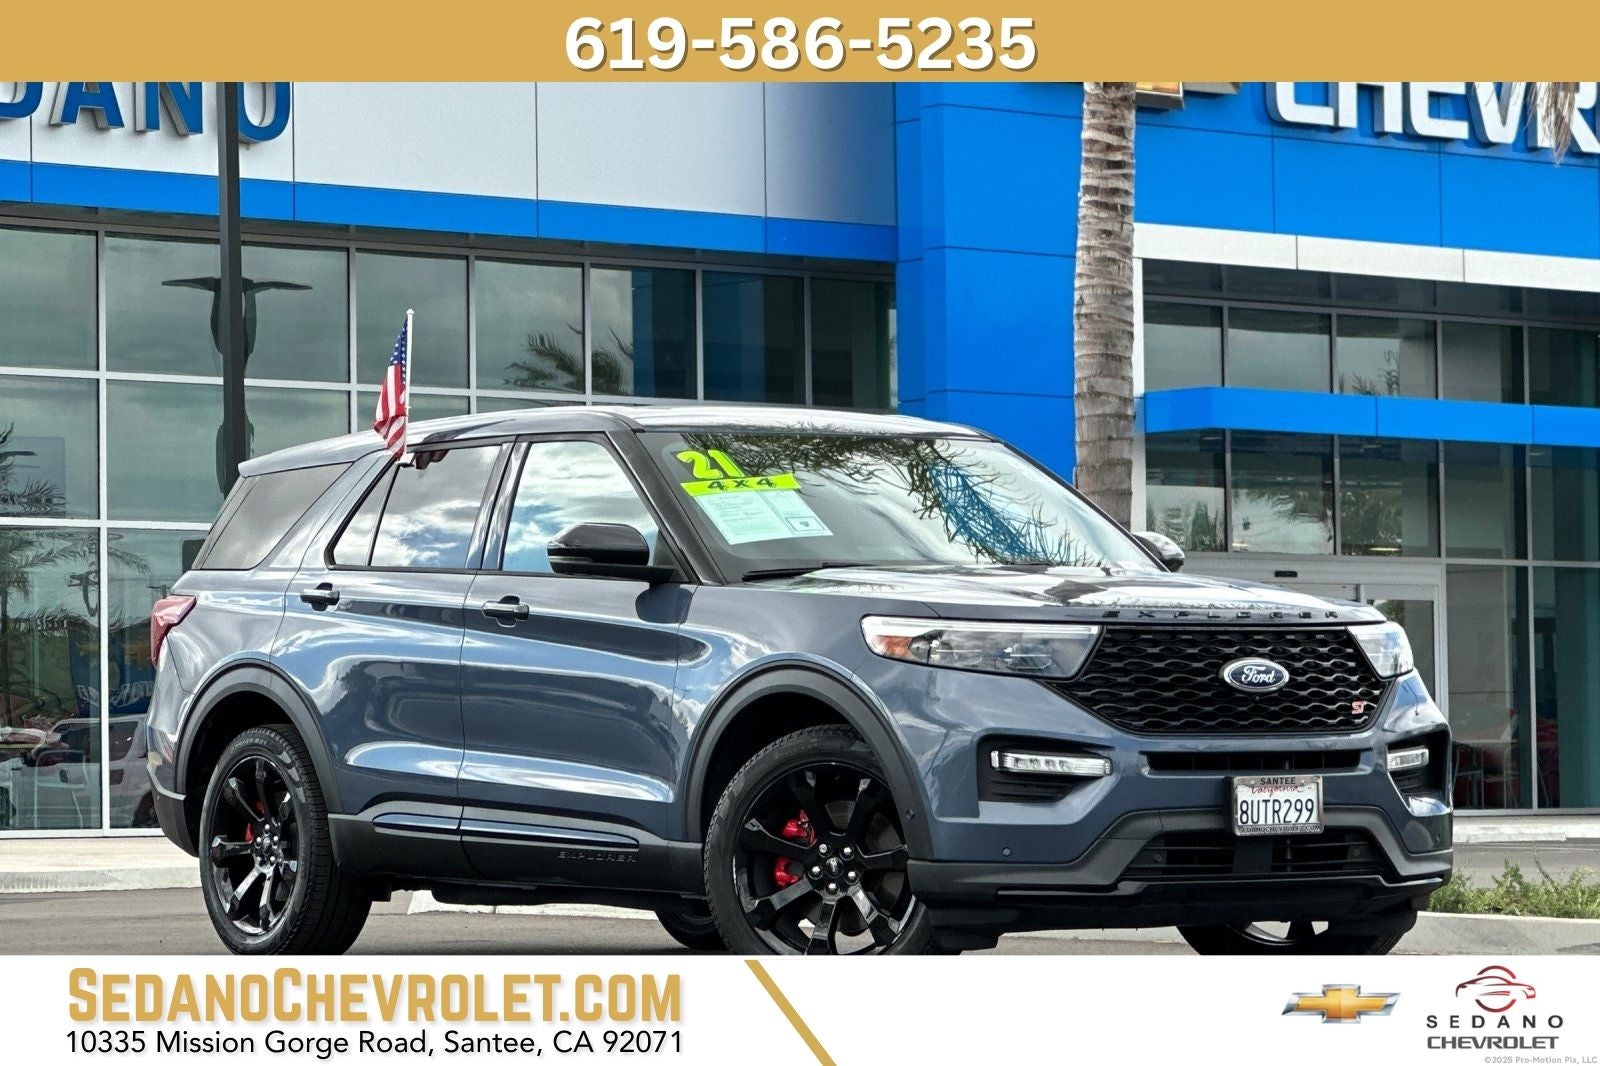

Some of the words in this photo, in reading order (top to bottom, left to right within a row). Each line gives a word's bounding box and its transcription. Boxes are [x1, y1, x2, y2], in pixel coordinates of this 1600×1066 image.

[676, 449, 745, 479] 21
[1240, 664, 1276, 686] Ford
[1351, 700, 1366, 715] ST
[1260, 776, 1297, 786] SANTEE
[1239, 798, 1315, 825] 8UTR299
[557, 850, 637, 863] EXPLORER
